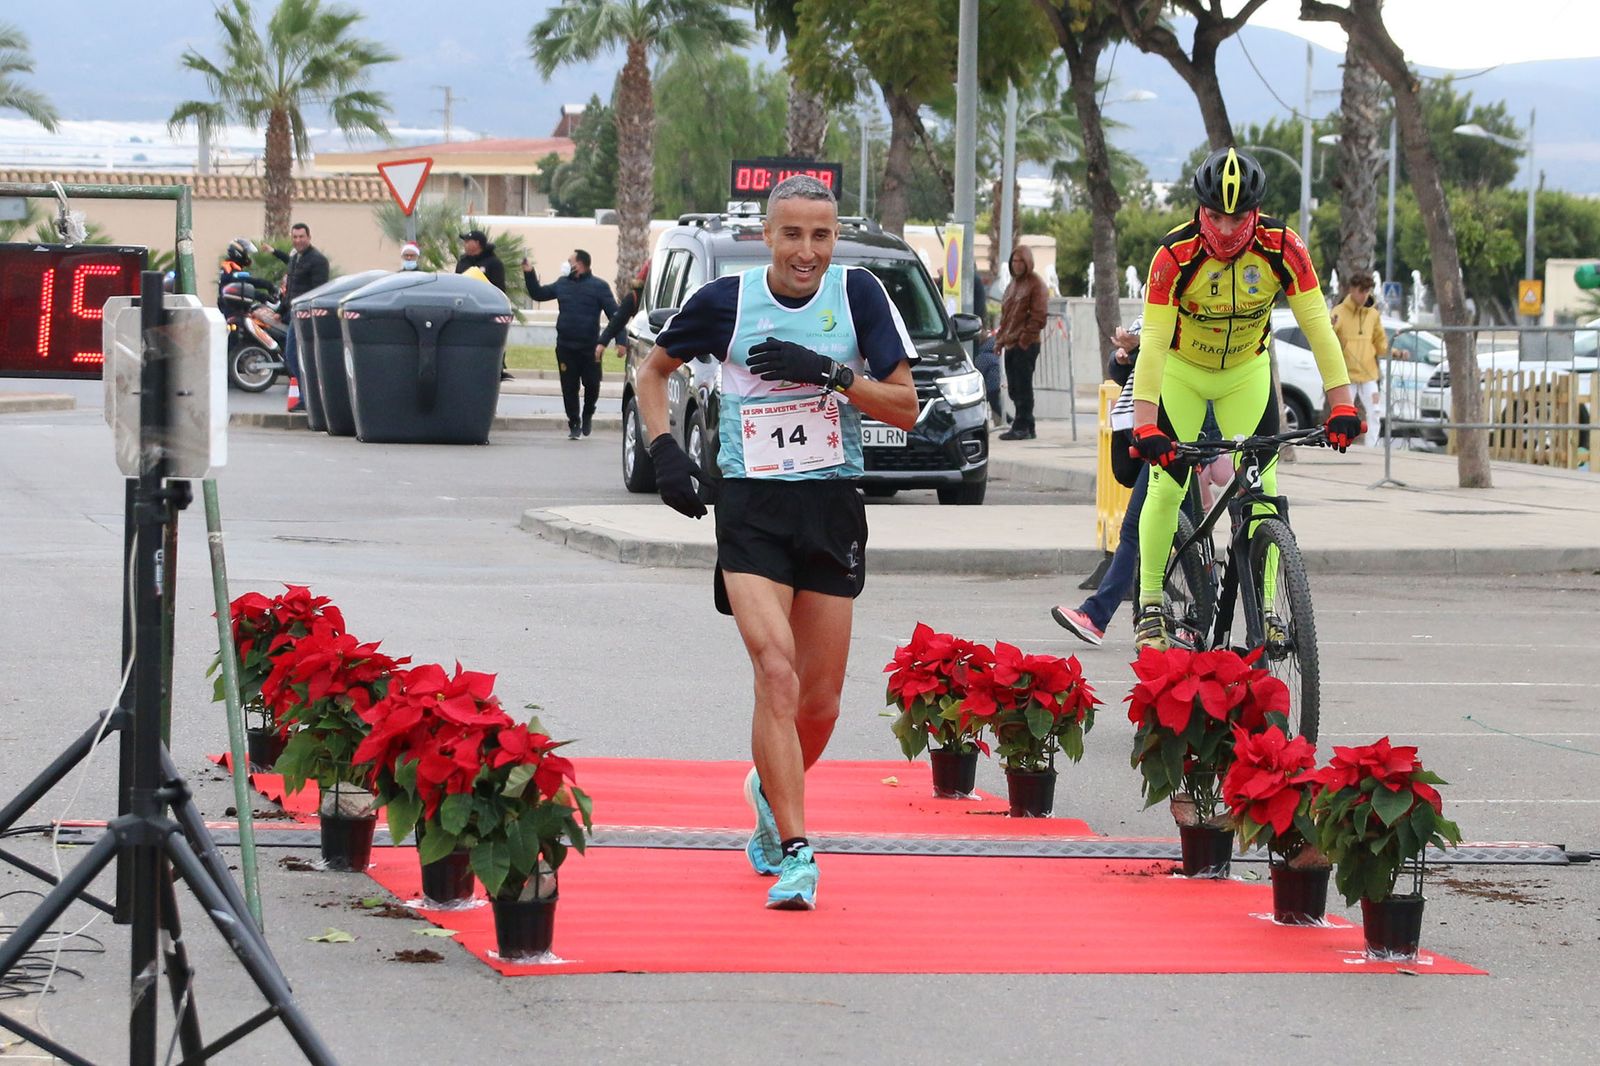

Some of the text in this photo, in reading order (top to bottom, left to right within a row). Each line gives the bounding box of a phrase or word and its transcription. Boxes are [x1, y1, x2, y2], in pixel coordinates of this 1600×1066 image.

[751, 407, 763, 415] SAN
[764, 403, 797, 414] SILVESTRE
[770, 424, 807, 448] 14
[877, 429, 904, 444] LRN
